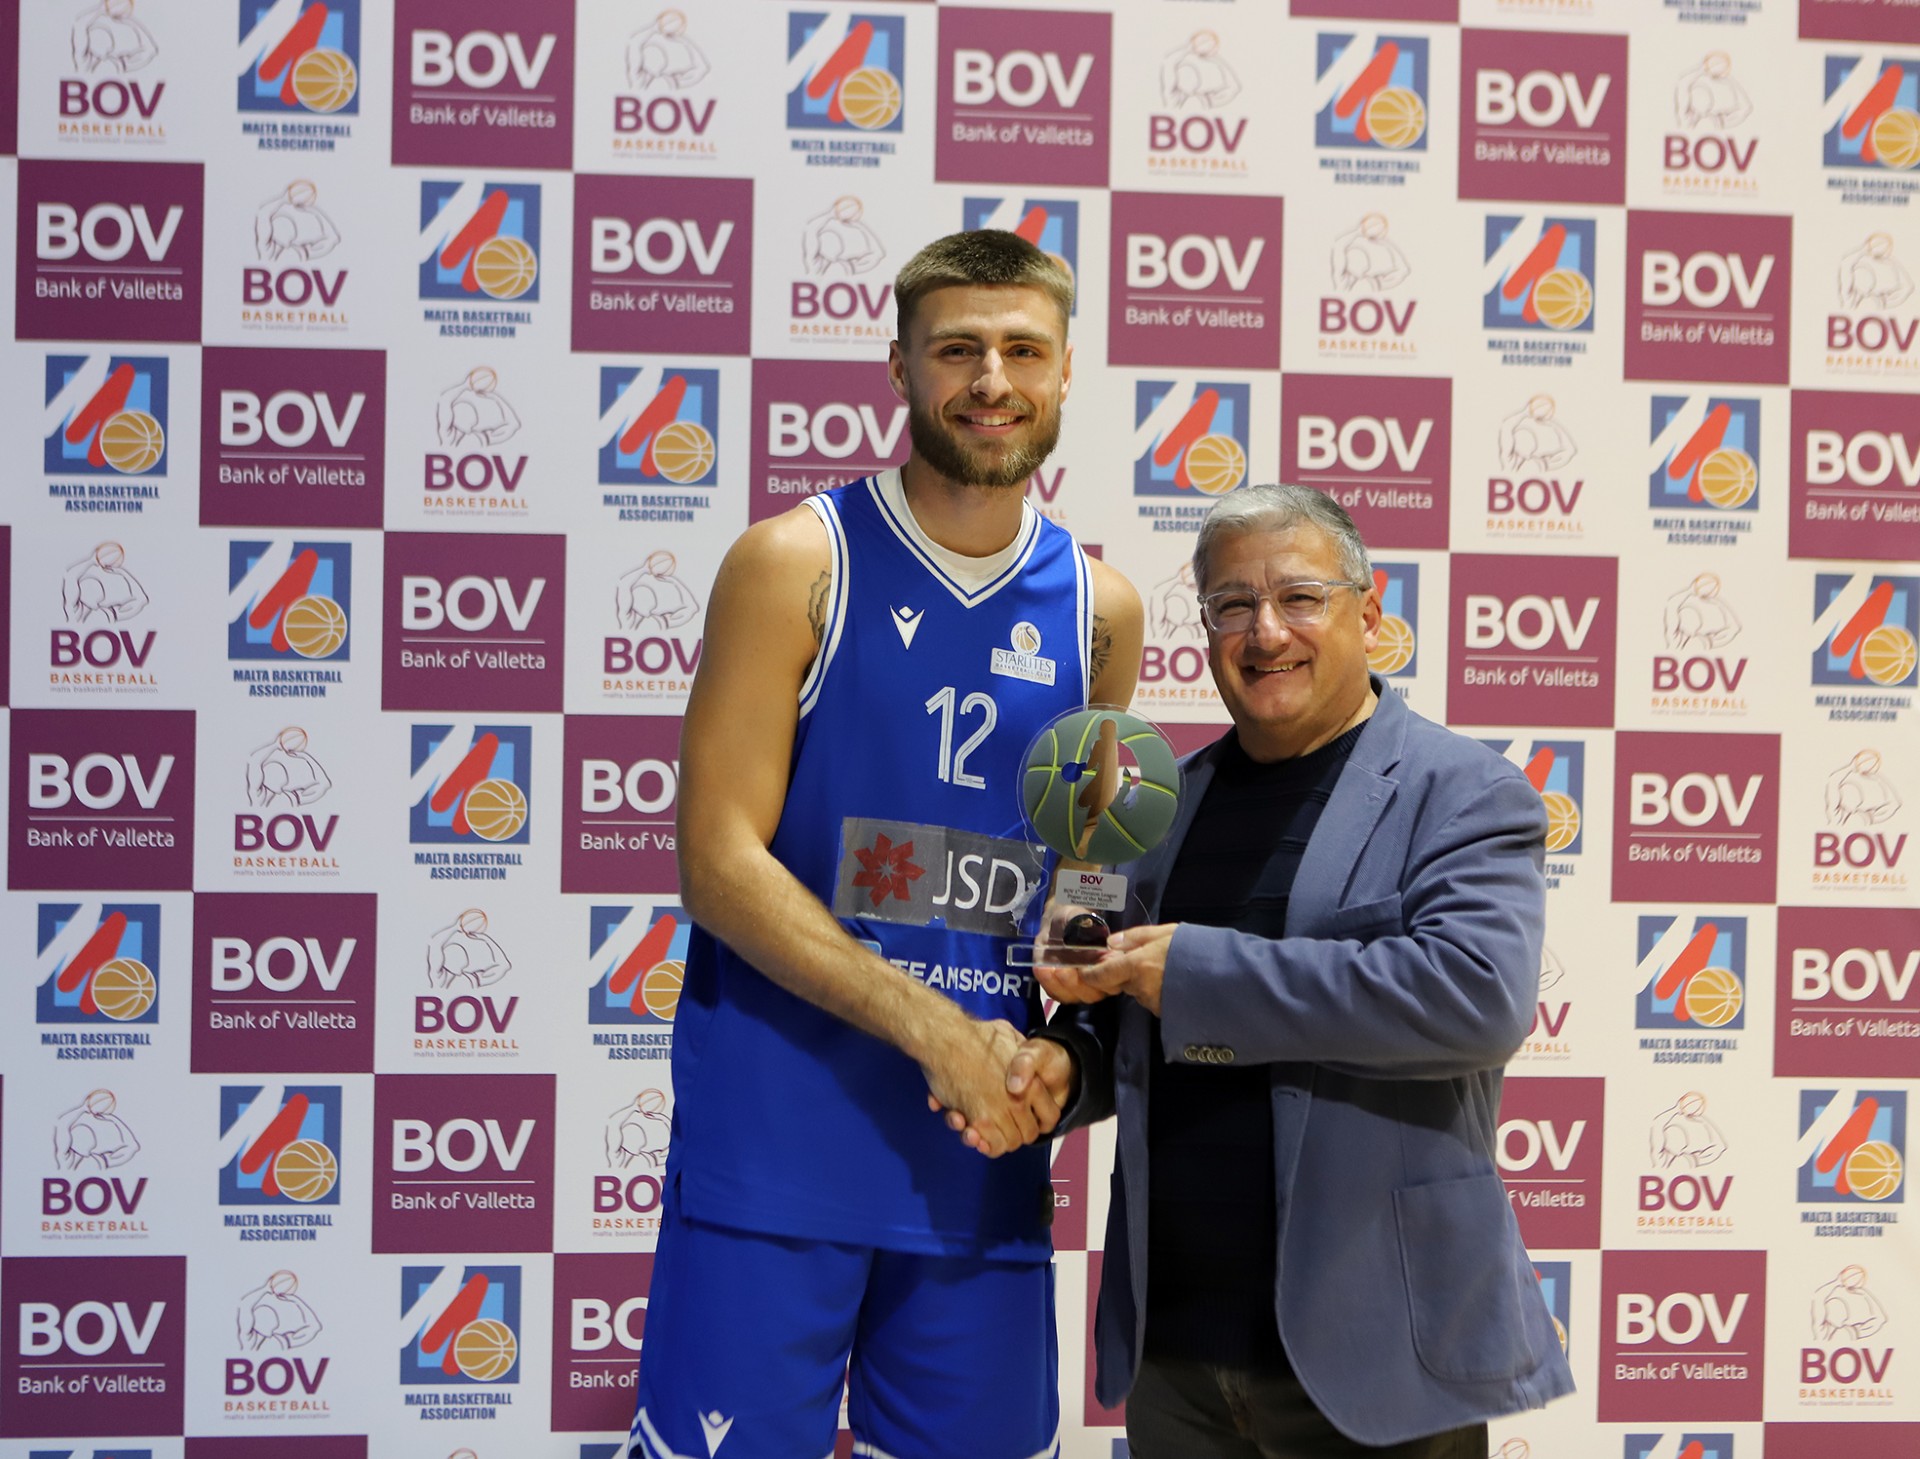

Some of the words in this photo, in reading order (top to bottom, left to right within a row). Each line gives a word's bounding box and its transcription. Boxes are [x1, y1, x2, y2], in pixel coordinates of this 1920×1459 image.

[411, 31, 556, 90] BOV
[59, 78, 166, 120] BOV
[1476, 71, 1611, 128] BOV
[411, 104, 456, 124] Bank
[459, 106, 480, 124] of
[484, 107, 555, 127] Valletta
[58, 123, 166, 136] BASKETBALL
[791, 138, 826, 152] MALTA
[829, 140, 896, 154] BASKETBALL
[1475, 142, 1517, 160] Bank
[1520, 144, 1540, 161] of
[1543, 145, 1610, 164] Valletta
[806, 154, 881, 168] ASSOCIATION
[35, 203, 184, 262] BOV
[591, 218, 734, 276] BOV
[1127, 235, 1265, 291] BOV
[35, 278, 81, 297] Bank
[85, 279, 106, 298] of
[110, 280, 183, 300] Valletta
[243, 266, 348, 308] BOV
[1642, 252, 1775, 308] BOV
[590, 291, 635, 310] Bank
[638, 292, 659, 310] of
[662, 293, 733, 313] Valletta
[242, 310, 348, 323] BASKETBALL
[424, 308, 460, 322] MALTA
[462, 309, 532, 324] BASKETBALL
[1126, 307, 1169, 325] Bank
[1172, 308, 1192, 326] of
[1195, 309, 1264, 328] Valletta
[440, 324, 516, 338] ASSOCIATION
[1641, 323, 1683, 341] Bank
[1686, 324, 1705, 342] of
[1708, 325, 1774, 344] Valletta
[1487, 339, 1520, 352] MALTA
[1523, 340, 1587, 353] BASKETBALL
[1502, 354, 1572, 367] ASSOCIATION
[220, 390, 366, 448] BOV
[219, 464, 265, 483] Bank
[268, 466, 289, 484] of
[293, 466, 365, 485] Valletta
[425, 452, 528, 493] BOV
[49, 484, 86, 497] MALTA
[88, 485, 159, 499] BASKETBALL
[603, 493, 639, 506] MALTA
[641, 494, 710, 508] BASKETBALL
[1487, 477, 1584, 516] BOV
[65, 499, 143, 513] ASSOCIATION
[424, 496, 529, 509] BASKETBALL
[619, 508, 694, 522] ASSOCIATION
[1486, 519, 1584, 531] BASKETBALL
[1653, 518, 1686, 530] MALTA
[1688, 519, 1752, 532] BASKETBALL
[1667, 532, 1737, 545] ASSOCIATION
[402, 576, 546, 632] BOV
[1465, 596, 1600, 650] BOV
[50, 628, 157, 669] BOV
[401, 649, 446, 667] Bank
[450, 650, 470, 668] of
[474, 651, 545, 669] Valletta
[996, 651, 1052, 673] STARLITES
[233, 669, 270, 682] MALTA
[272, 669, 342, 683] BASKETBALL
[995, 662, 1034, 675] BASKETBALL
[1464, 667, 1506, 684] Bank
[1509, 667, 1528, 685] of
[1532, 668, 1598, 686] Valletta
[1652, 655, 1748, 693] BOV
[50, 673, 157, 685] BASKETBALL
[249, 684, 326, 697] ASSOCIATION
[1652, 697, 1748, 708] BASKETBALL
[925, 686, 997, 790] 12
[27, 753, 175, 809] BOV
[1630, 773, 1763, 826] BOV
[27, 827, 73, 846] Bank
[77, 828, 98, 846] of
[101, 828, 175, 847] Valletta
[234, 813, 339, 852] BOV
[414, 852, 450, 865] MALTA
[453, 853, 522, 865] BASKETBALL
[1629, 844, 1670, 861] Bank
[1673, 844, 1692, 861] of
[1695, 845, 1761, 862] Valletta
[233, 857, 339, 868] BASKETBALL
[430, 867, 506, 880] ASSOCIATION
[932, 850, 1026, 913] JSD
[1080, 874, 1104, 885] BOV
[211, 937, 357, 991] BOV
[210, 1010, 256, 1028] Bank
[259, 1011, 280, 1028] of
[284, 1011, 356, 1029] Valletta
[415, 995, 519, 1033] BOV
[41, 1032, 78, 1045] MALTA
[80, 1032, 151, 1045] BASKETBALL
[414, 1039, 519, 1049] BASKETBALL
[1639, 1038, 1672, 1050] MALTA
[1674, 1038, 1738, 1050] BASKETBALL
[57, 1047, 135, 1060] ASSOCIATION
[1653, 1052, 1723, 1064] ASSOCIATION
[392, 1118, 536, 1172] BOV
[42, 1177, 148, 1215] BOV
[391, 1191, 436, 1209] Bank
[440, 1191, 460, 1209] of
[464, 1191, 535, 1209] Valletta
[1638, 1175, 1734, 1211] BOV
[41, 1221, 148, 1231] BASKETBALL
[224, 1214, 260, 1226] MALTA
[262, 1214, 332, 1226] BASKETBALL
[1637, 1216, 1733, 1226] BASKETBALL
[1800, 1212, 1833, 1223] MALTA
[1835, 1211, 1898, 1223] BASKETBALL
[240, 1229, 316, 1241] ASSOCIATION
[1814, 1226, 1883, 1237] ASSOCIATION
[1616, 1292, 1749, 1344] BOV
[19, 1301, 166, 1356] BOV
[1615, 1363, 1657, 1380] Bank
[1660, 1363, 1678, 1379] of
[1682, 1362, 1747, 1379] Valletta
[1800, 1347, 1894, 1384] BOV
[18, 1375, 65, 1393] Bank
[68, 1375, 89, 1393] of
[93, 1375, 166, 1393] Valletta
[225, 1357, 330, 1396] BOV
[405, 1393, 441, 1406] MALTA
[443, 1392, 512, 1405] BASKETBALL
[1799, 1388, 1894, 1399] BASKETBALL
[224, 1400, 330, 1411] BASKETBALL
[421, 1407, 496, 1420] ASSOCIATION
